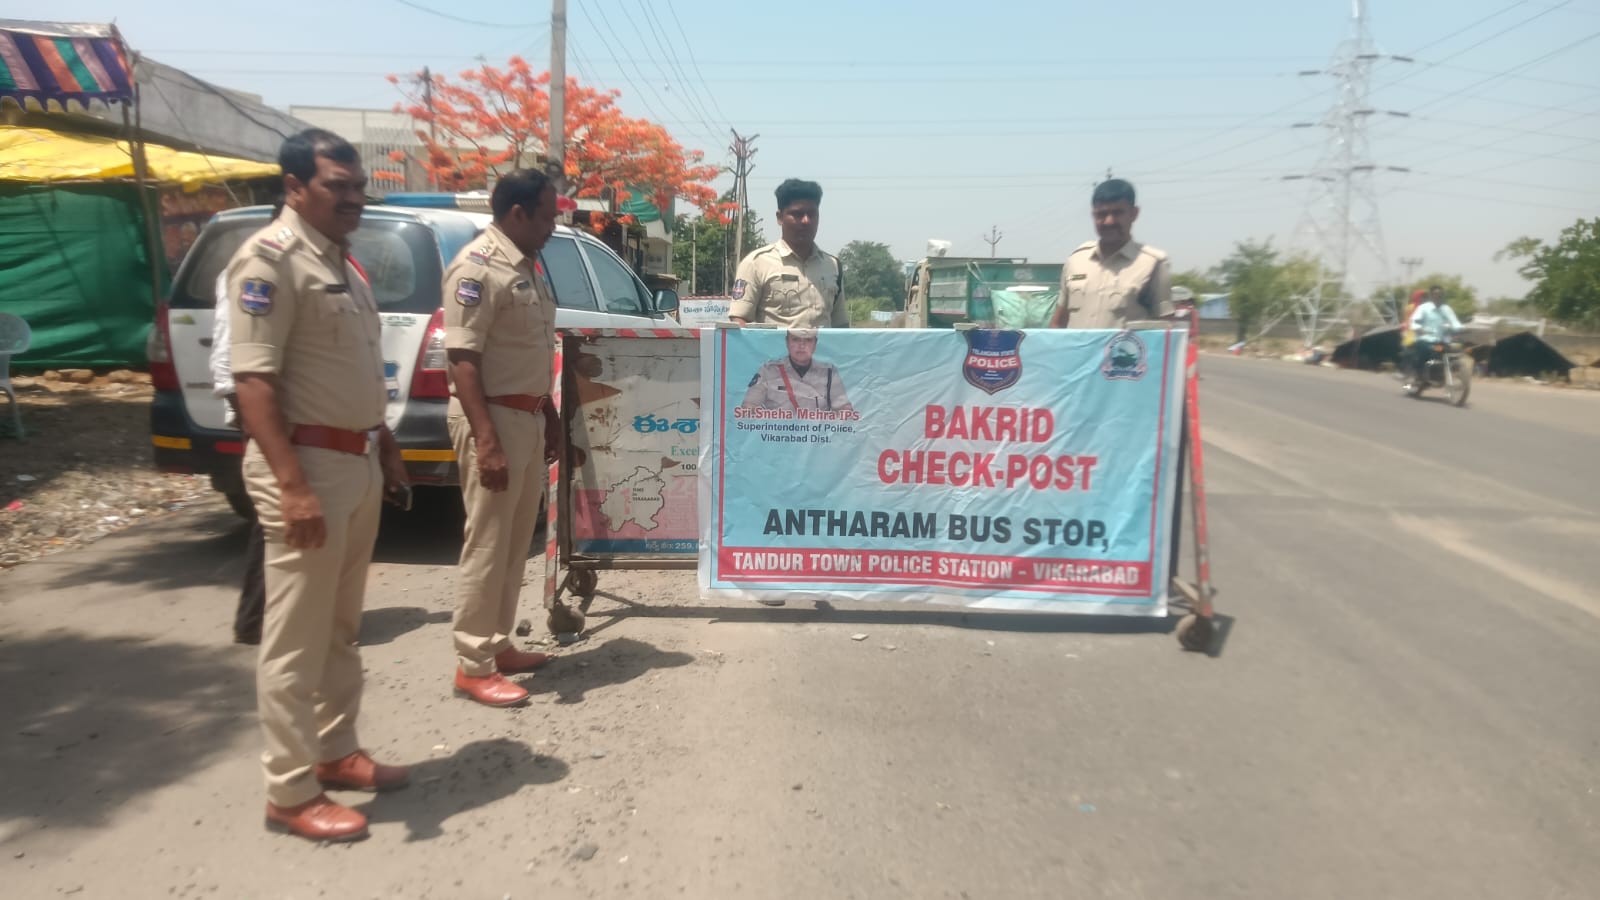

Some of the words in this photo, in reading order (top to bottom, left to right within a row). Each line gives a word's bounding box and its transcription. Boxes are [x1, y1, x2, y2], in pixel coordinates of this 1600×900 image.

[968, 355, 1017, 369] POLICE
[797, 408, 836, 421] Mehra
[839, 410, 860, 421] IPS
[924, 404, 1055, 443] BAKRID
[737, 422, 809, 432] Superintendent
[812, 424, 822, 432] of
[824, 424, 856, 433] Police,
[761, 433, 808, 443] Vikarabad
[810, 434, 832, 443] Dist.
[877, 448, 1099, 491] CHECK-POST
[763, 508, 937, 539] ANTHARAM
[948, 514, 1012, 543] BUS
[1023, 517, 1109, 552] STOP,
[732, 552, 804, 571] TANDUR
[809, 553, 862, 572] TOWN
[868, 555, 932, 574] POLICE
[938, 557, 1013, 580] STATION
[1033, 562, 1139, 585] VIKARABAD
